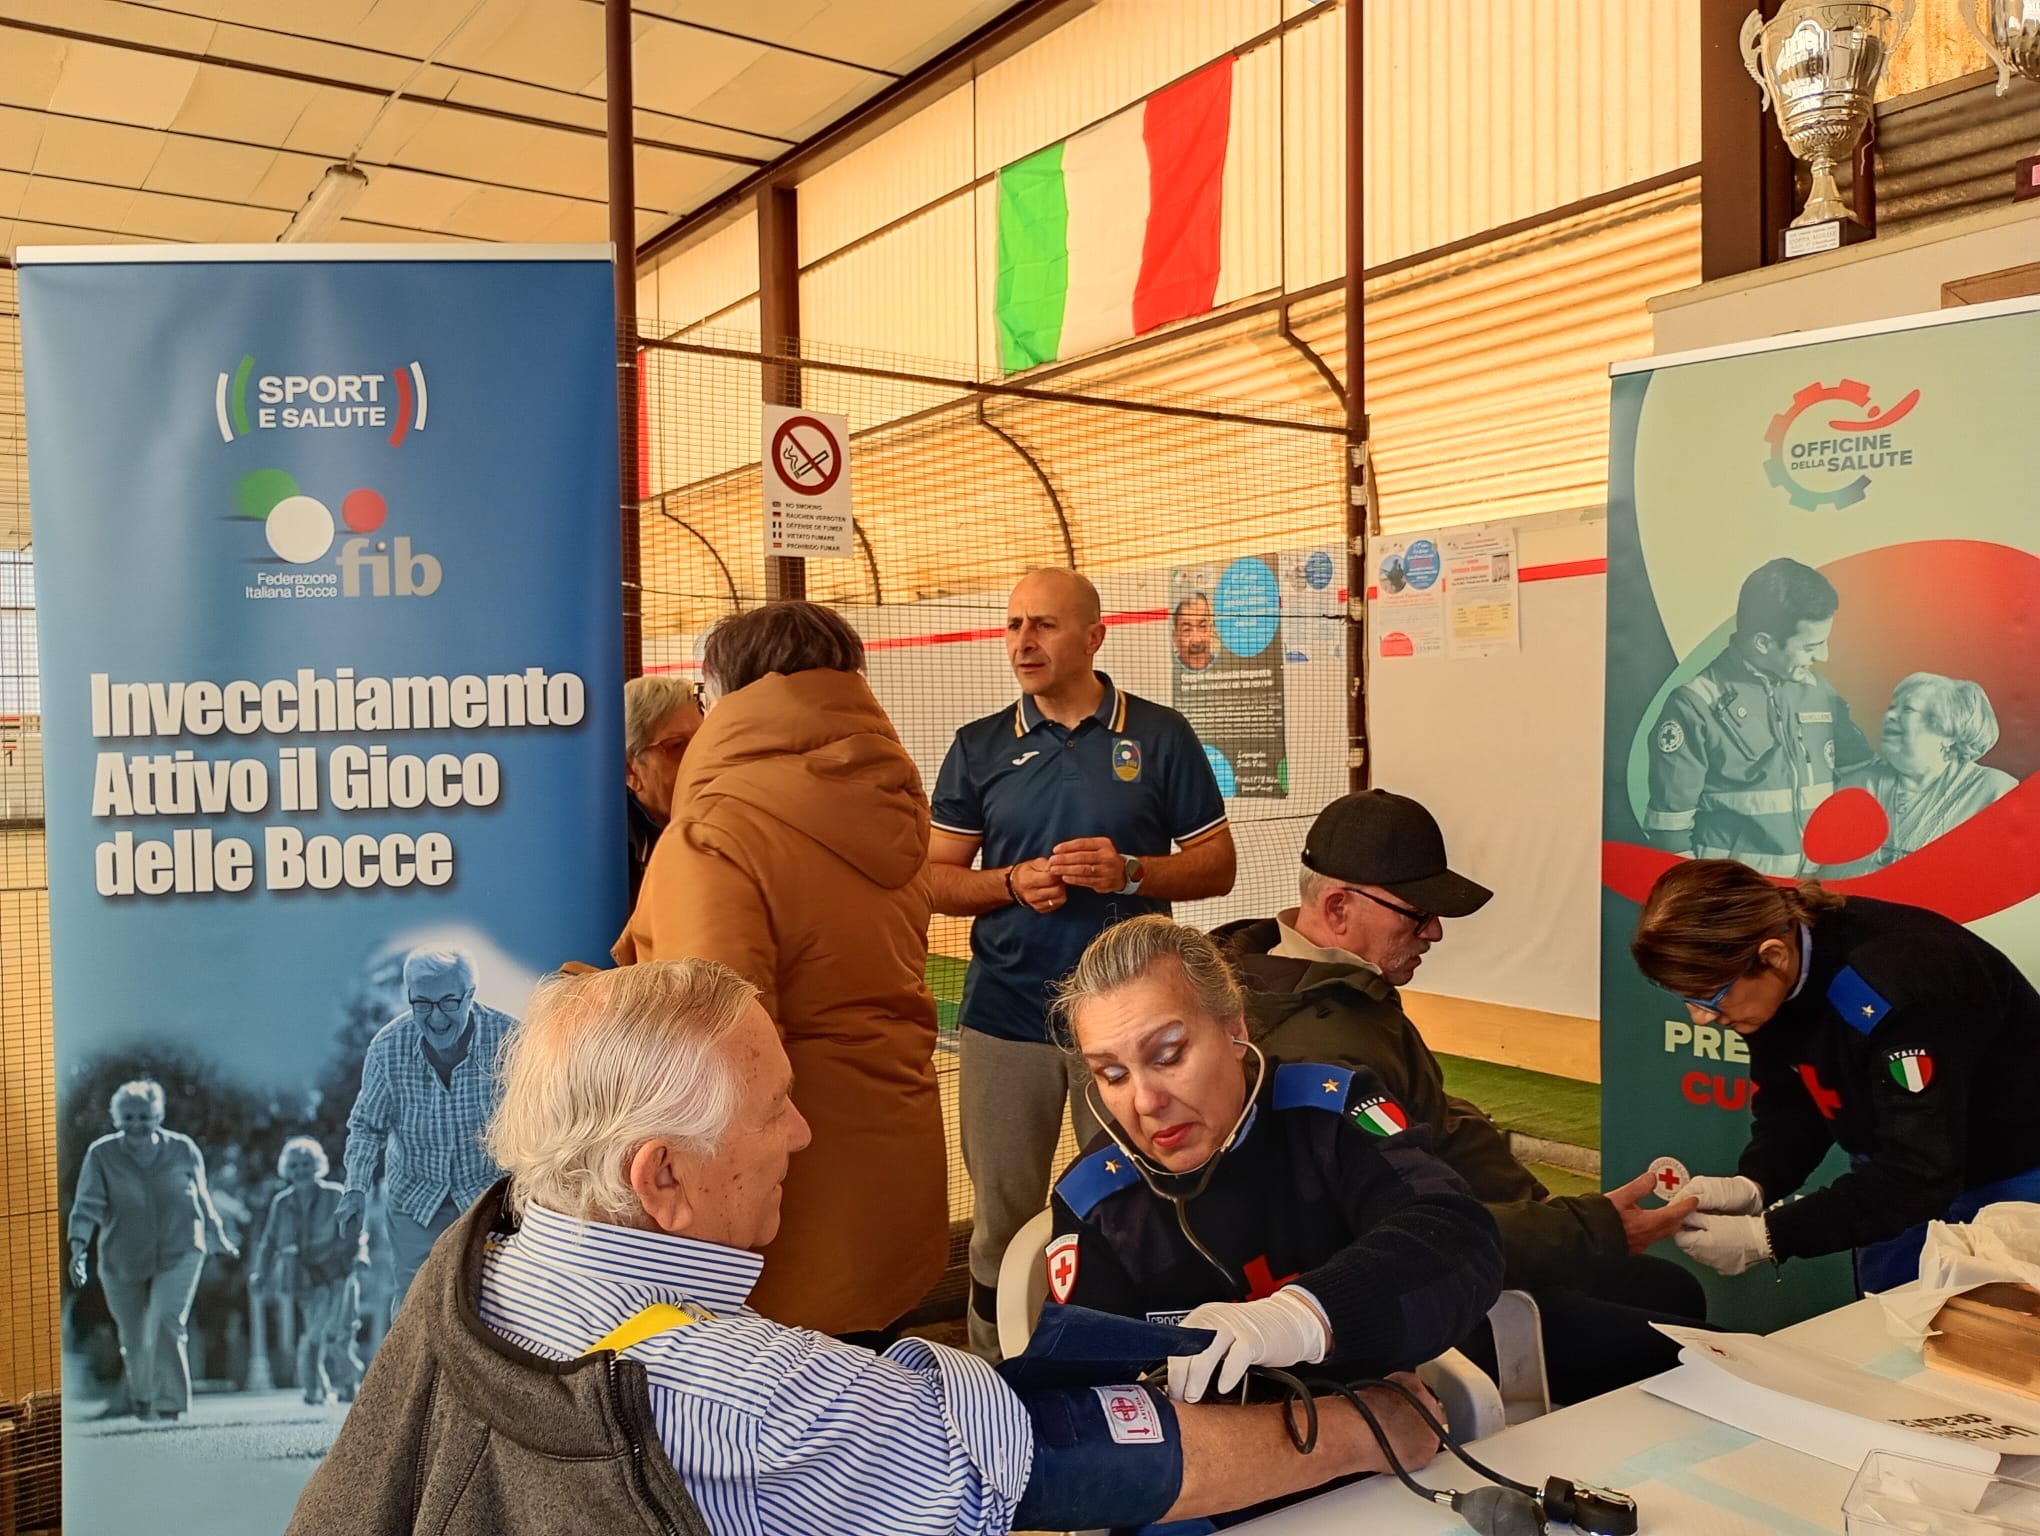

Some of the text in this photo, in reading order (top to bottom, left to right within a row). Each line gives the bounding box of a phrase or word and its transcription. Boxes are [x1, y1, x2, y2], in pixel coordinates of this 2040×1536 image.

[258, 374, 385, 404] SPORT
[258, 406, 386, 429] E SALUTE
[1790, 433, 1892, 459] OFFICINE
[1791, 450, 1913, 472] DELLA SALUTE
[786, 512, 815, 520] RAUCHEN
[786, 543, 819, 551] PROHIBIDO
[335, 536, 443, 598] fib
[257, 572, 338, 586] Federazione
[245, 585, 338, 599] Italiana Bocce
[90, 667, 586, 738] Invecchiamento
[91, 744, 501, 817] Attivo il Gioco
[95, 826, 454, 897] delle Bocce
[1888, 1049, 1926, 1061] ITALIA
[1681, 1070, 1760, 1111] CU
[1350, 1096, 1387, 1116] ITALIA
